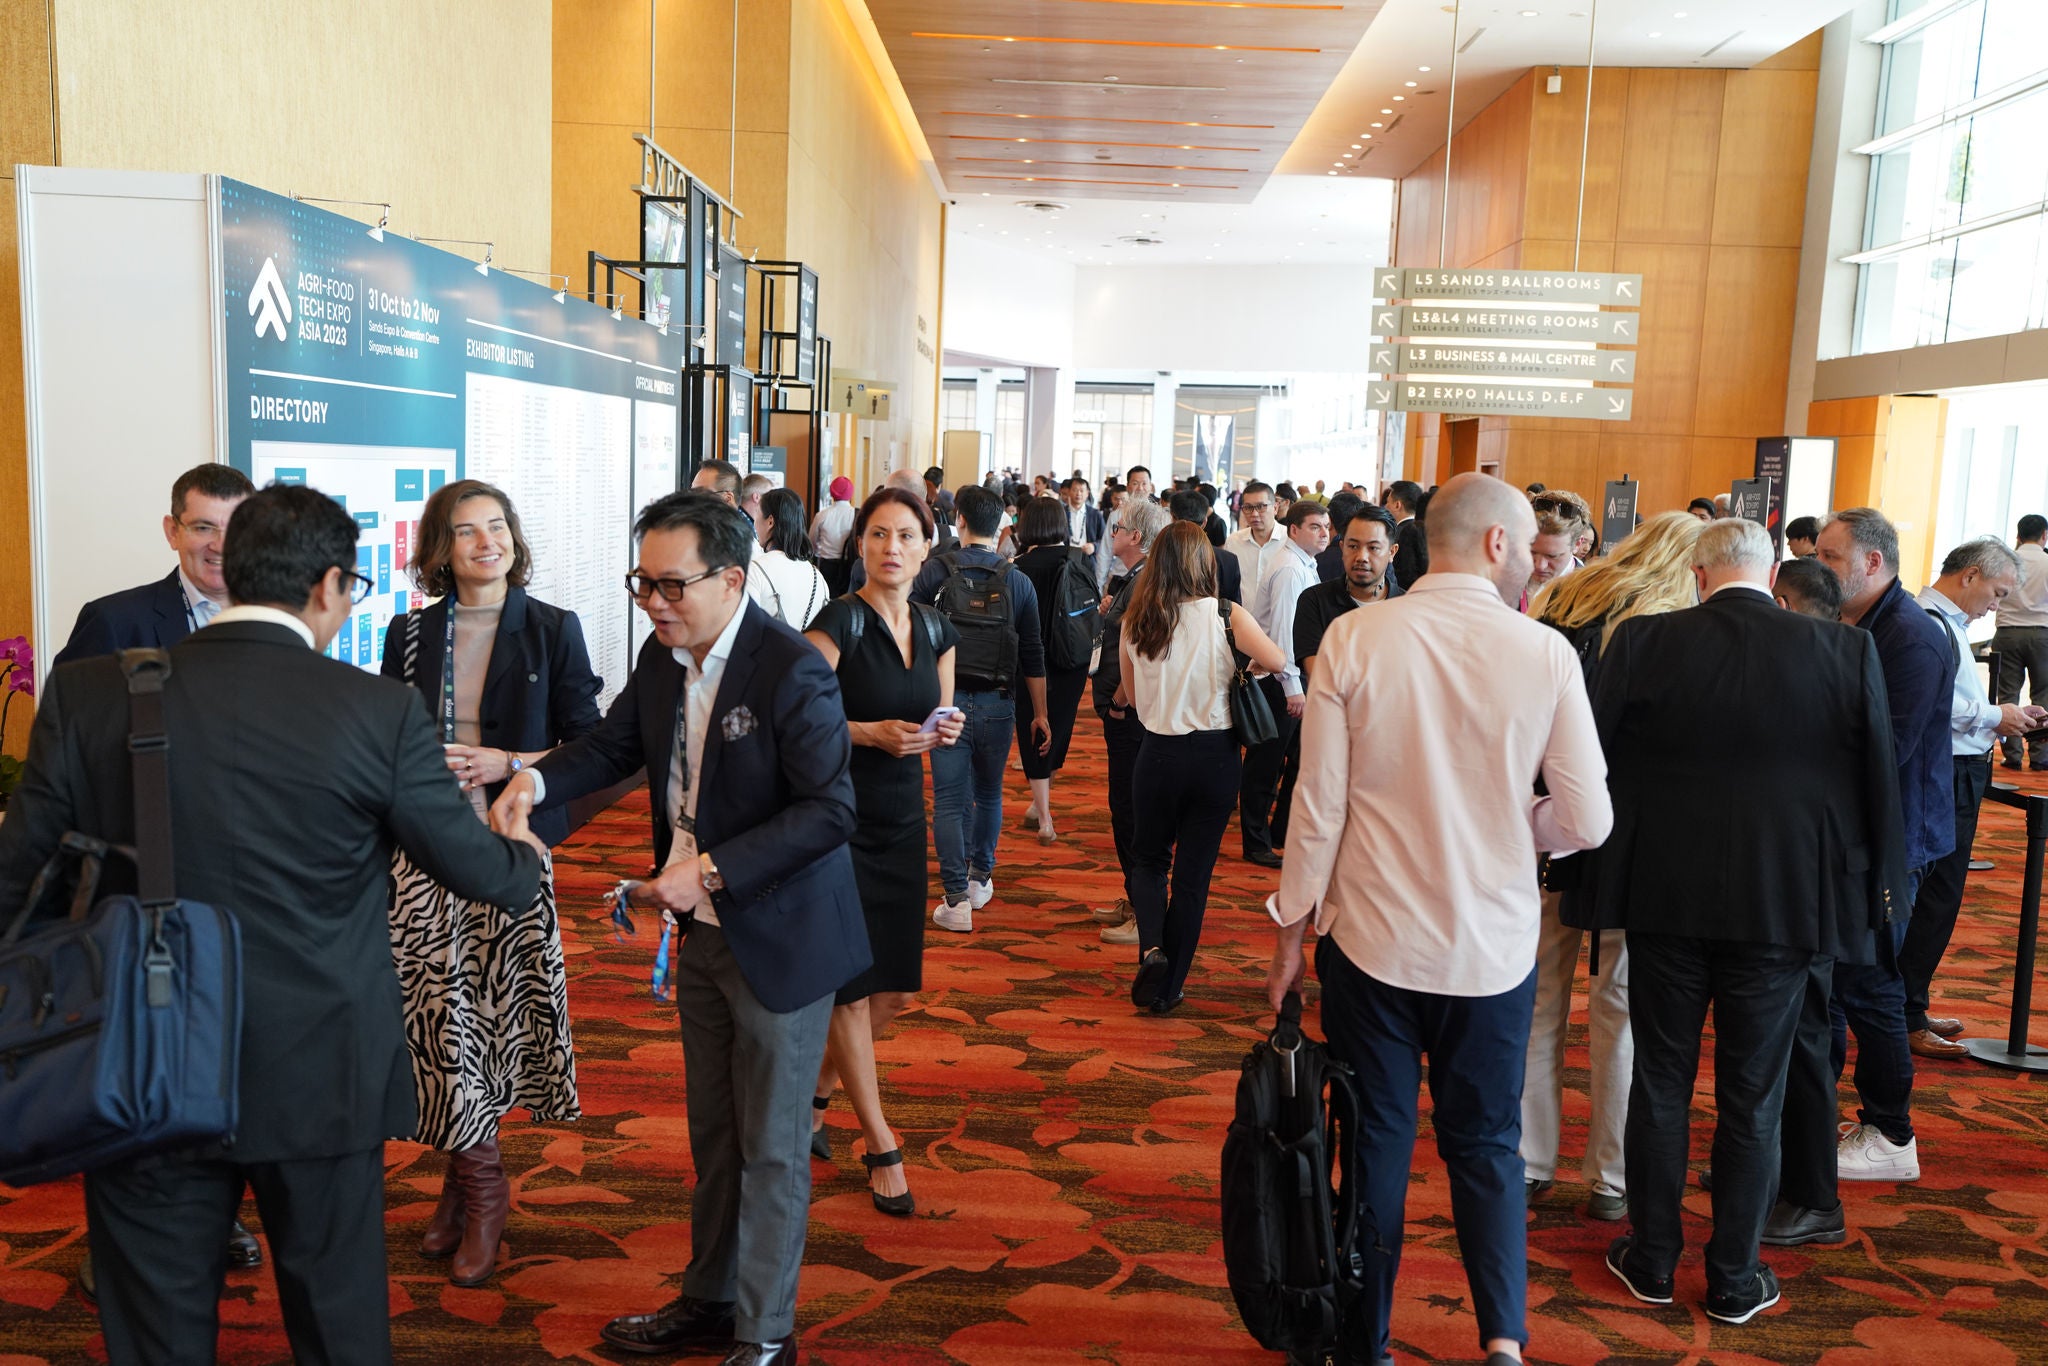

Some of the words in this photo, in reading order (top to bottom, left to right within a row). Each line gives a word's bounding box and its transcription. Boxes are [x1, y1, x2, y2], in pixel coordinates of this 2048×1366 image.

[643, 144, 687, 216] EXPO
[298, 272, 355, 302] AGRI-FOOD
[1415, 273, 1433, 285] L5
[1440, 274, 1495, 287] SANDS
[1502, 275, 1601, 290] BALLROOMS
[298, 296, 325, 319] TECH
[327, 302, 352, 324] EXPO
[369, 287, 378, 311] 31
[381, 292, 399, 316] Oct
[401, 297, 411, 319] to
[413, 299, 420, 321] 2
[421, 302, 440, 325] Nov
[299, 320, 322, 342] ASIA
[323, 324, 347, 346] 2023
[369, 320, 383, 334] Sands
[384, 324, 396, 338] Expo
[400, 327, 425, 342] Convention
[425, 331, 440, 344] Centre
[1412, 312, 1460, 324] L3&L4
[1466, 313, 1537, 327] MEETING
[1543, 315, 1600, 329] ROOMS
[369, 340, 393, 356] Singapore,
[393, 344, 404, 357] Halls
[466, 339, 506, 364] EXHIBITOR
[507, 346, 535, 369] LISTING
[1409, 349, 1427, 361] L3
[1434, 349, 1495, 363] BUSINESS
[1497, 351, 1507, 363] &
[1511, 352, 1543, 365] MAIL
[1546, 353, 1597, 367] CENTRE
[1407, 386, 1426, 398] B2
[1433, 387, 1477, 400] EXPO
[1484, 389, 1535, 403] HALLS
[250, 395, 329, 424] DIRECTORY
